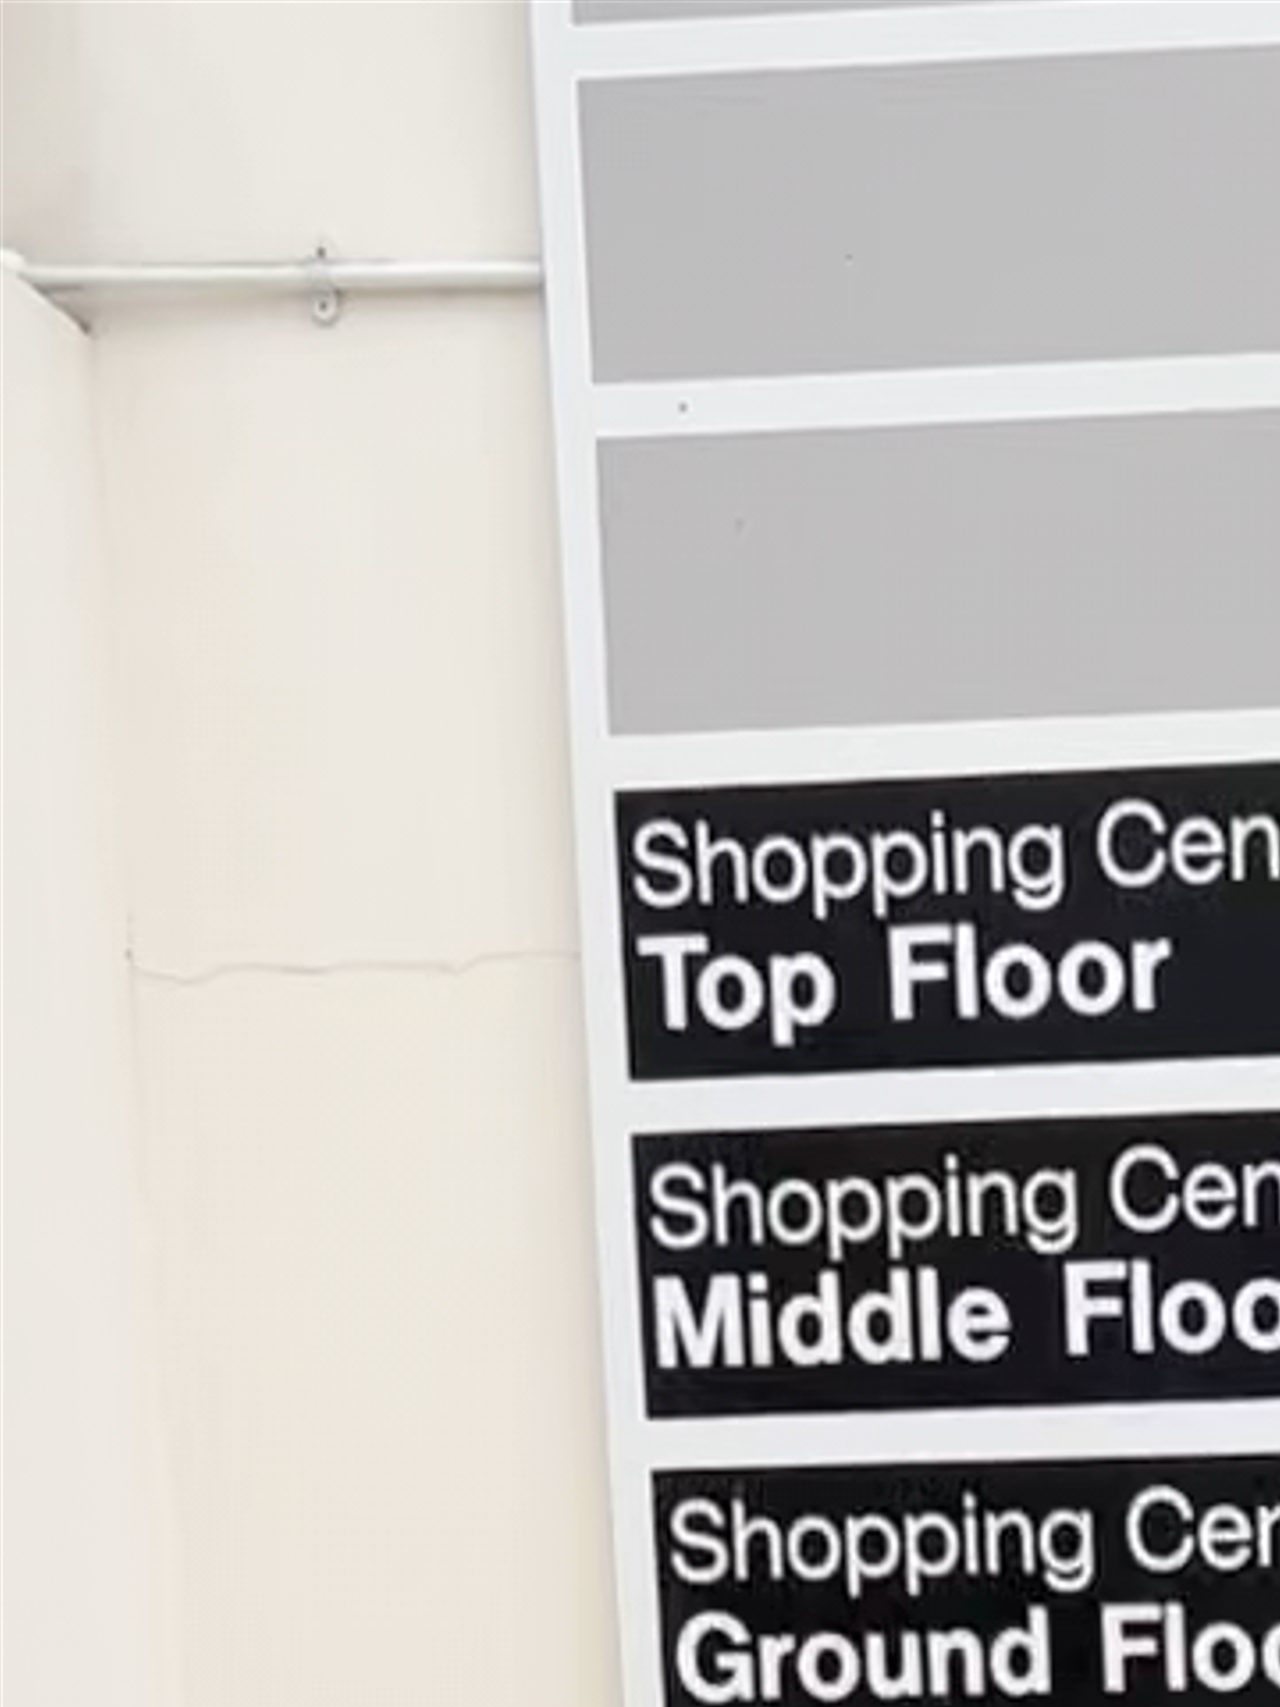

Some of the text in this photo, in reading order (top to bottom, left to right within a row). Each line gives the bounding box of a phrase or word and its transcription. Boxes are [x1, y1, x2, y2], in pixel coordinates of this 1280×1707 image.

[635, 811, 1063, 919] Shopping
[638, 923, 1170, 1045] Top Floor
[651, 1155, 1077, 1260] Shopping
[655, 1268, 1009, 1368] Middle
[672, 1494, 1093, 1597] Shopping
[677, 1606, 1050, 1702] Ground
